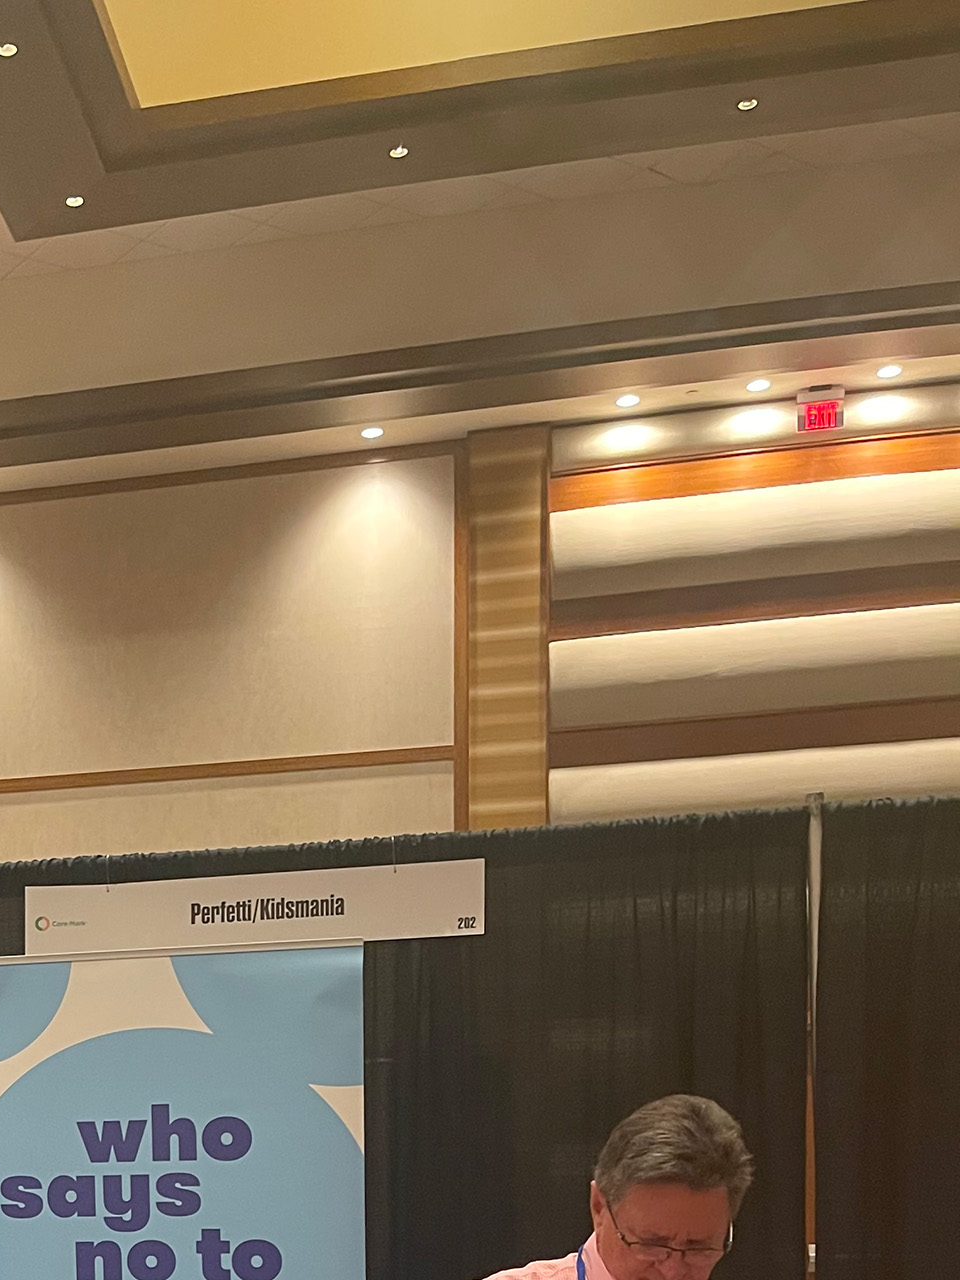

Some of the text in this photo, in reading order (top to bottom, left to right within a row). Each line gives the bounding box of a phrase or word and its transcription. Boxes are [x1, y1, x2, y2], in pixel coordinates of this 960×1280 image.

[804, 402, 839, 430] EXIT
[190, 893, 345, 926] Perfetti/Kidsmania
[457, 916, 477, 930] 202
[76, 1103, 253, 1163] who
[0, 1171, 202, 1233] says
